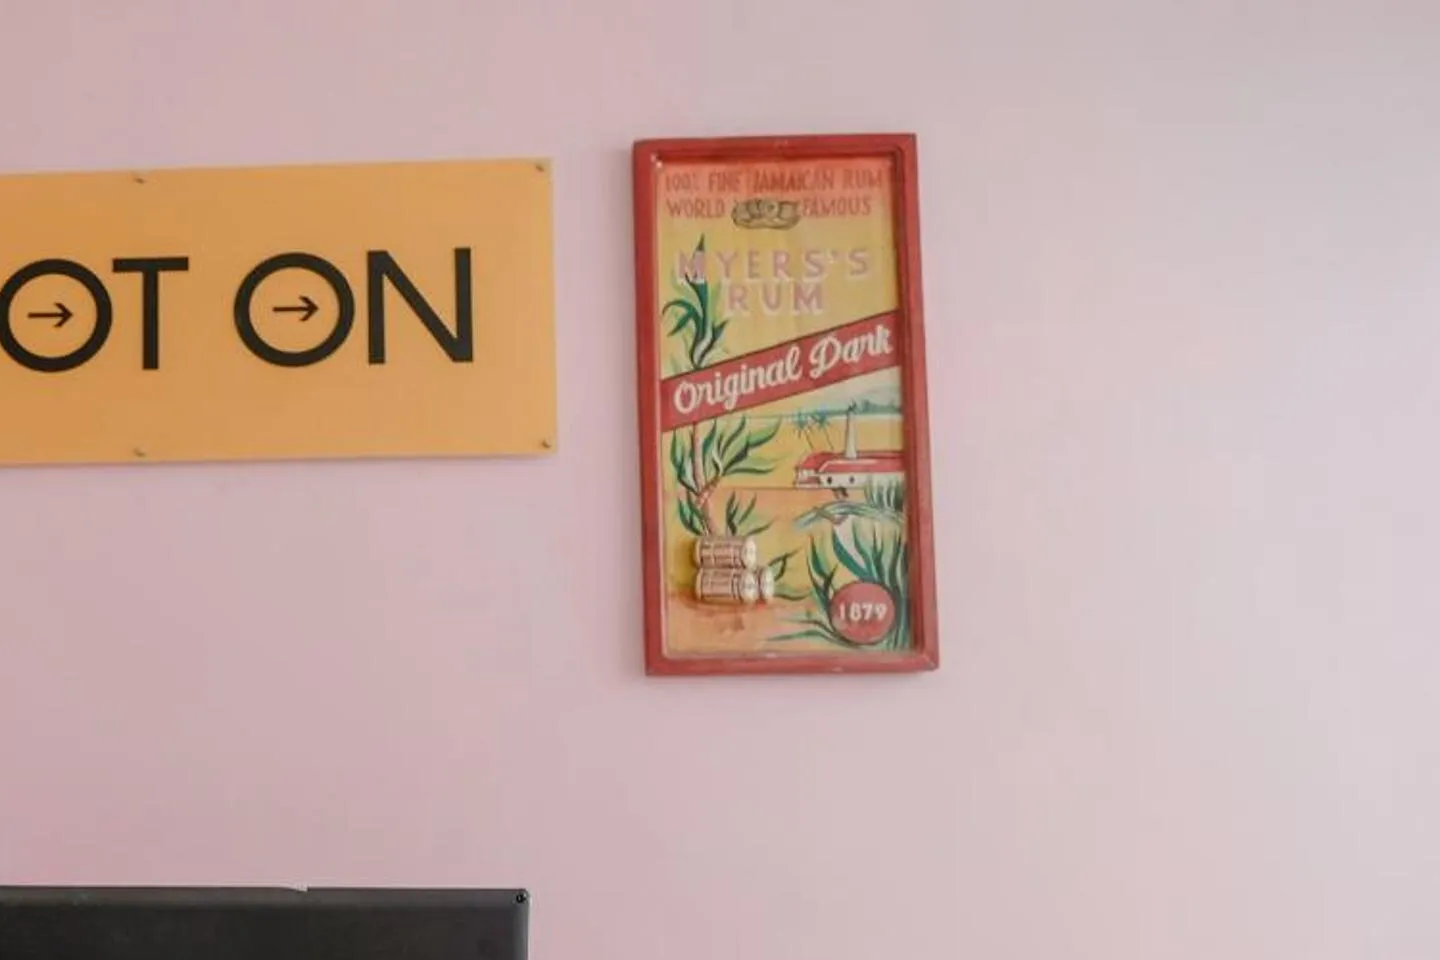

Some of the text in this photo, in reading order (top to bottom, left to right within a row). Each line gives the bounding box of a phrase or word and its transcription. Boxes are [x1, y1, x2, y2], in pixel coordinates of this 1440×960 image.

[708, 169, 741, 192] FINE
[752, 167, 835, 193] JAMAICAN
[843, 167, 884, 190] RUM
[665, 196, 872, 219] WORLD FAMOUS
[676, 248, 871, 281] MYERS'S
[233, 246, 474, 367] ON
[725, 282, 824, 315] RUM
[673, 324, 893, 414] Original Dark
[838, 601, 889, 621] 1879
